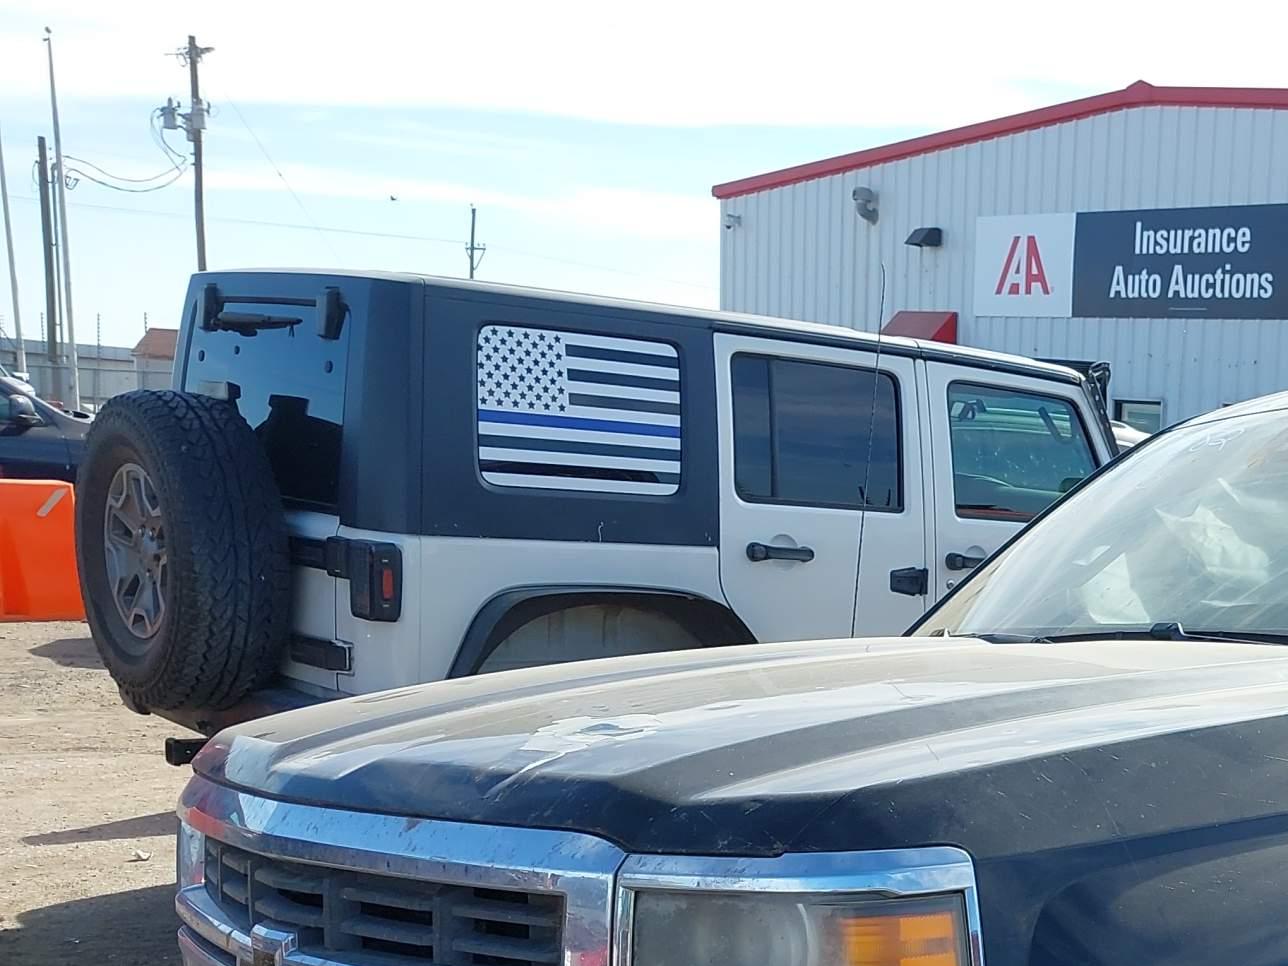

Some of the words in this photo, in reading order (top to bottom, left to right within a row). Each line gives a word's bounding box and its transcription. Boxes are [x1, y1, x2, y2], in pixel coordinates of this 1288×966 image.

[1134, 221, 1252, 255] Insurance
[1109, 265, 1161, 299] Auto
[1167, 263, 1273, 299] Auctions
